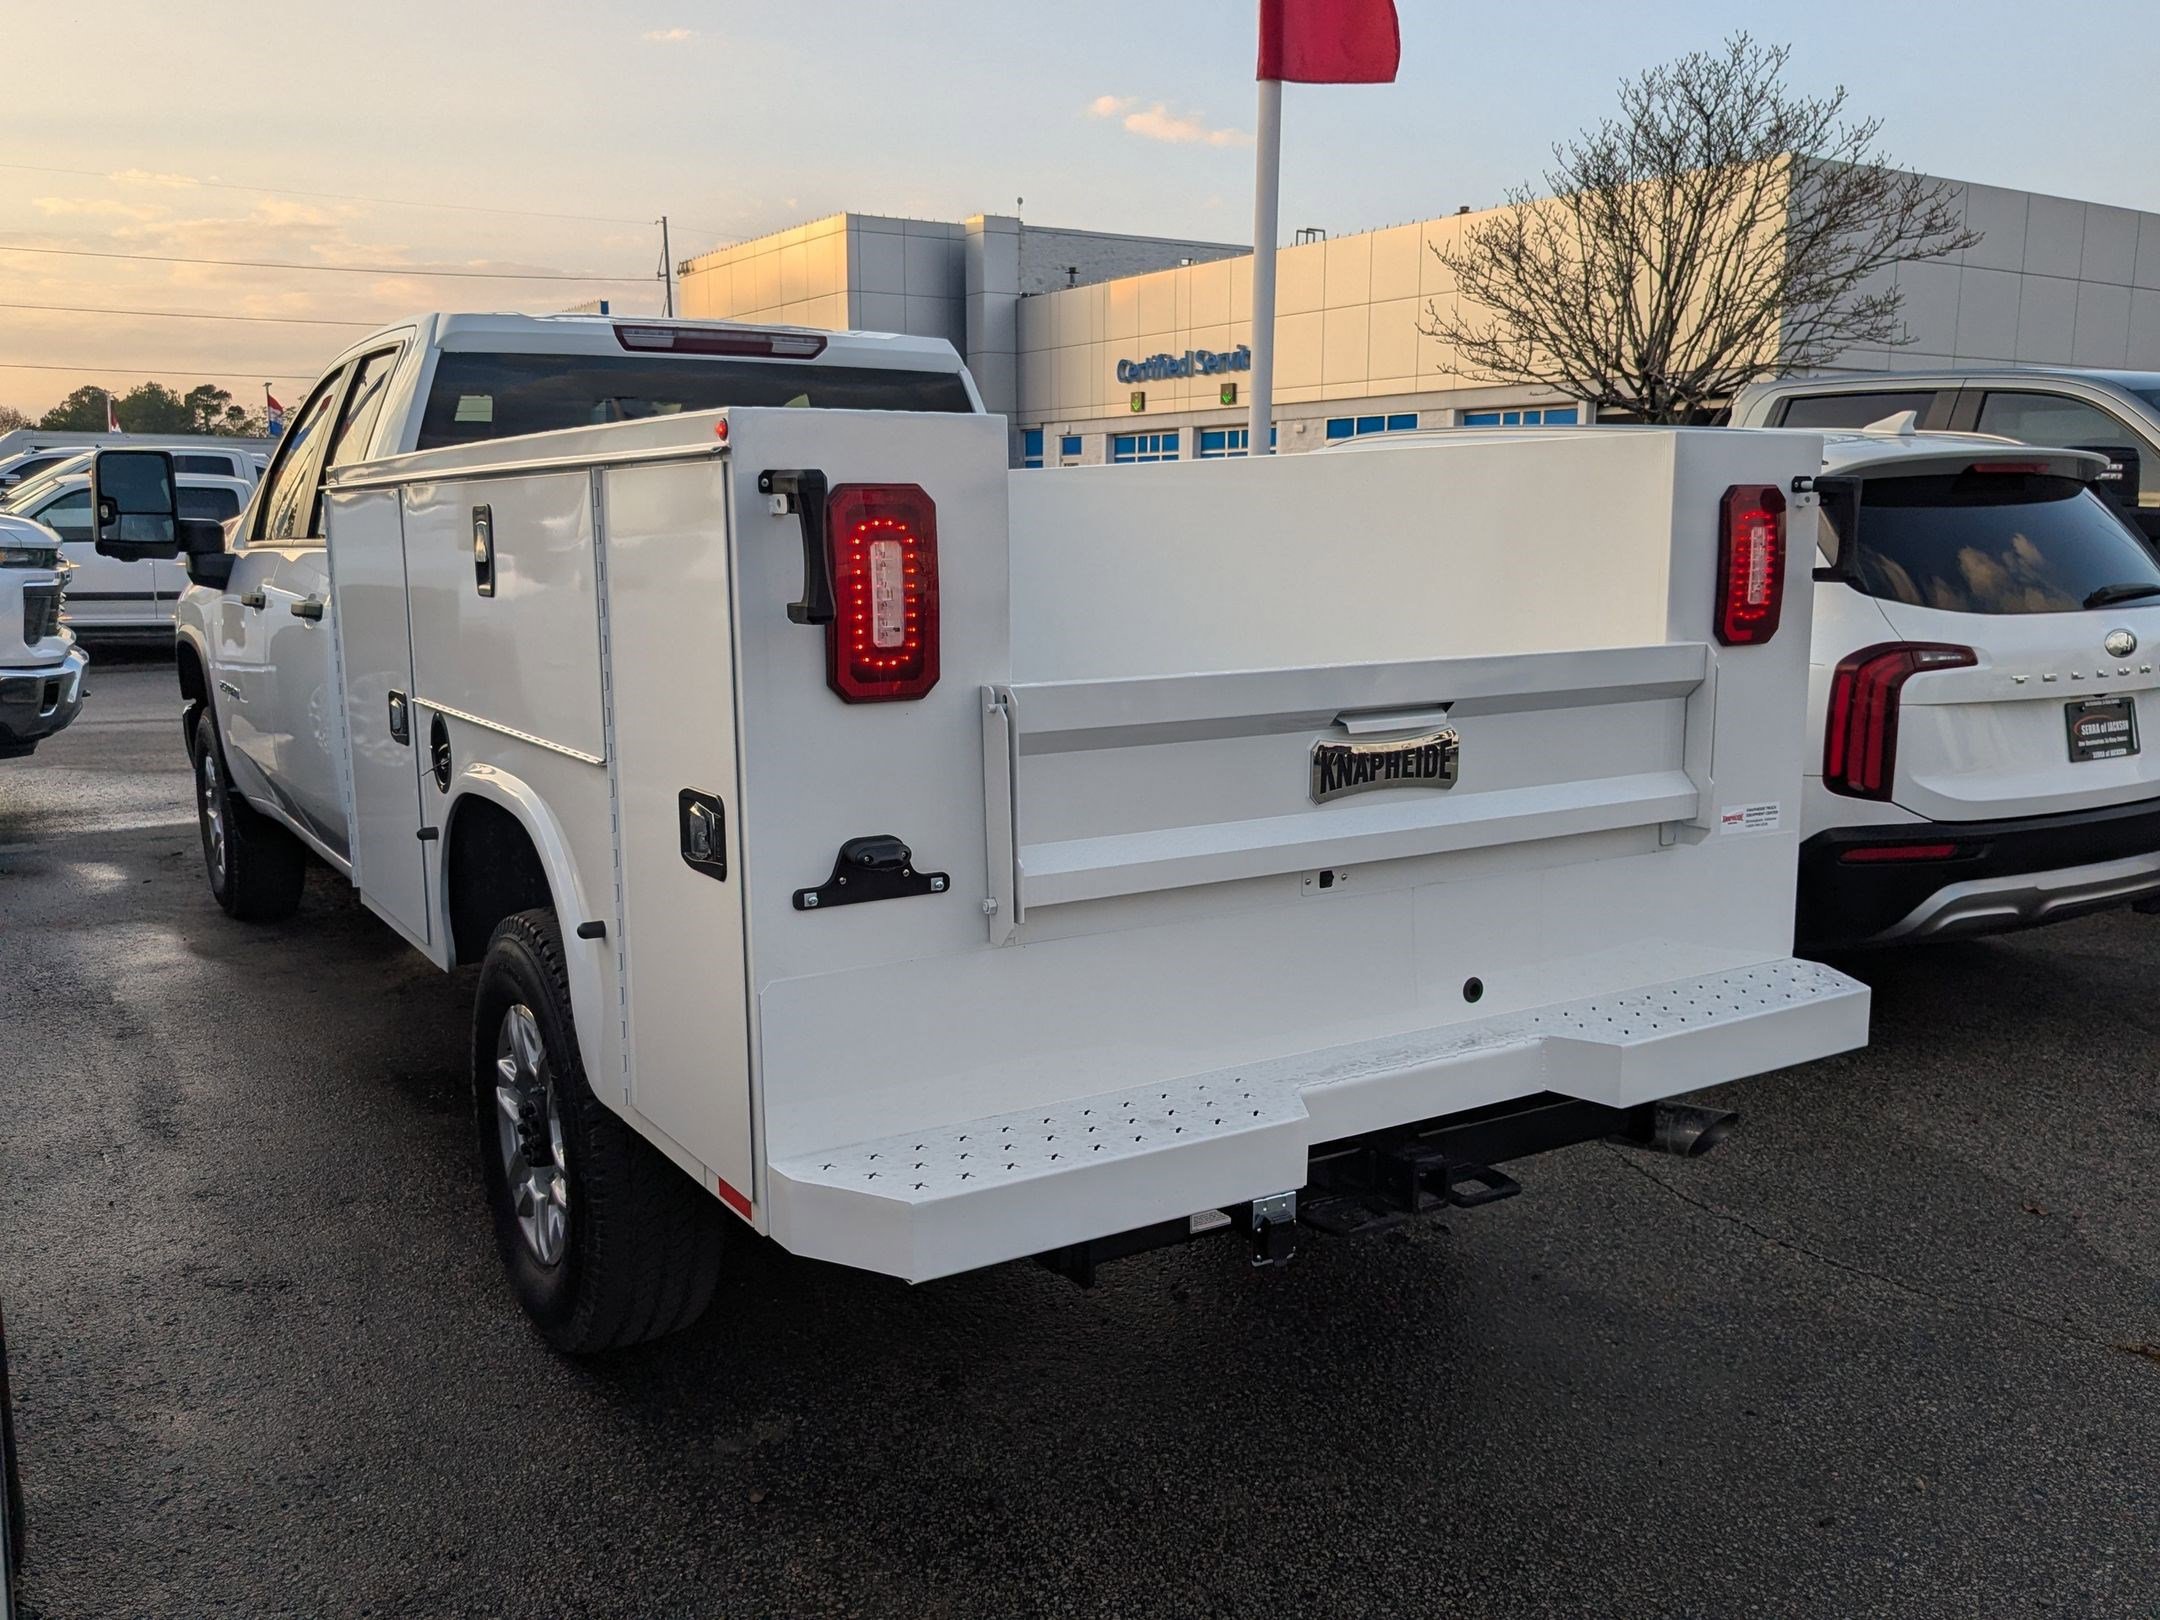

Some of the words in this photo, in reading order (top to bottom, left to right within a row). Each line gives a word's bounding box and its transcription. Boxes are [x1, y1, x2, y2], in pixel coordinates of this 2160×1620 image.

[1117, 351, 1195, 384] Certified
[1195, 344, 1251, 375] Servic
[2011, 664, 2160, 684] TELLUR
[1320, 739, 1452, 794] KNAPHEIDE
